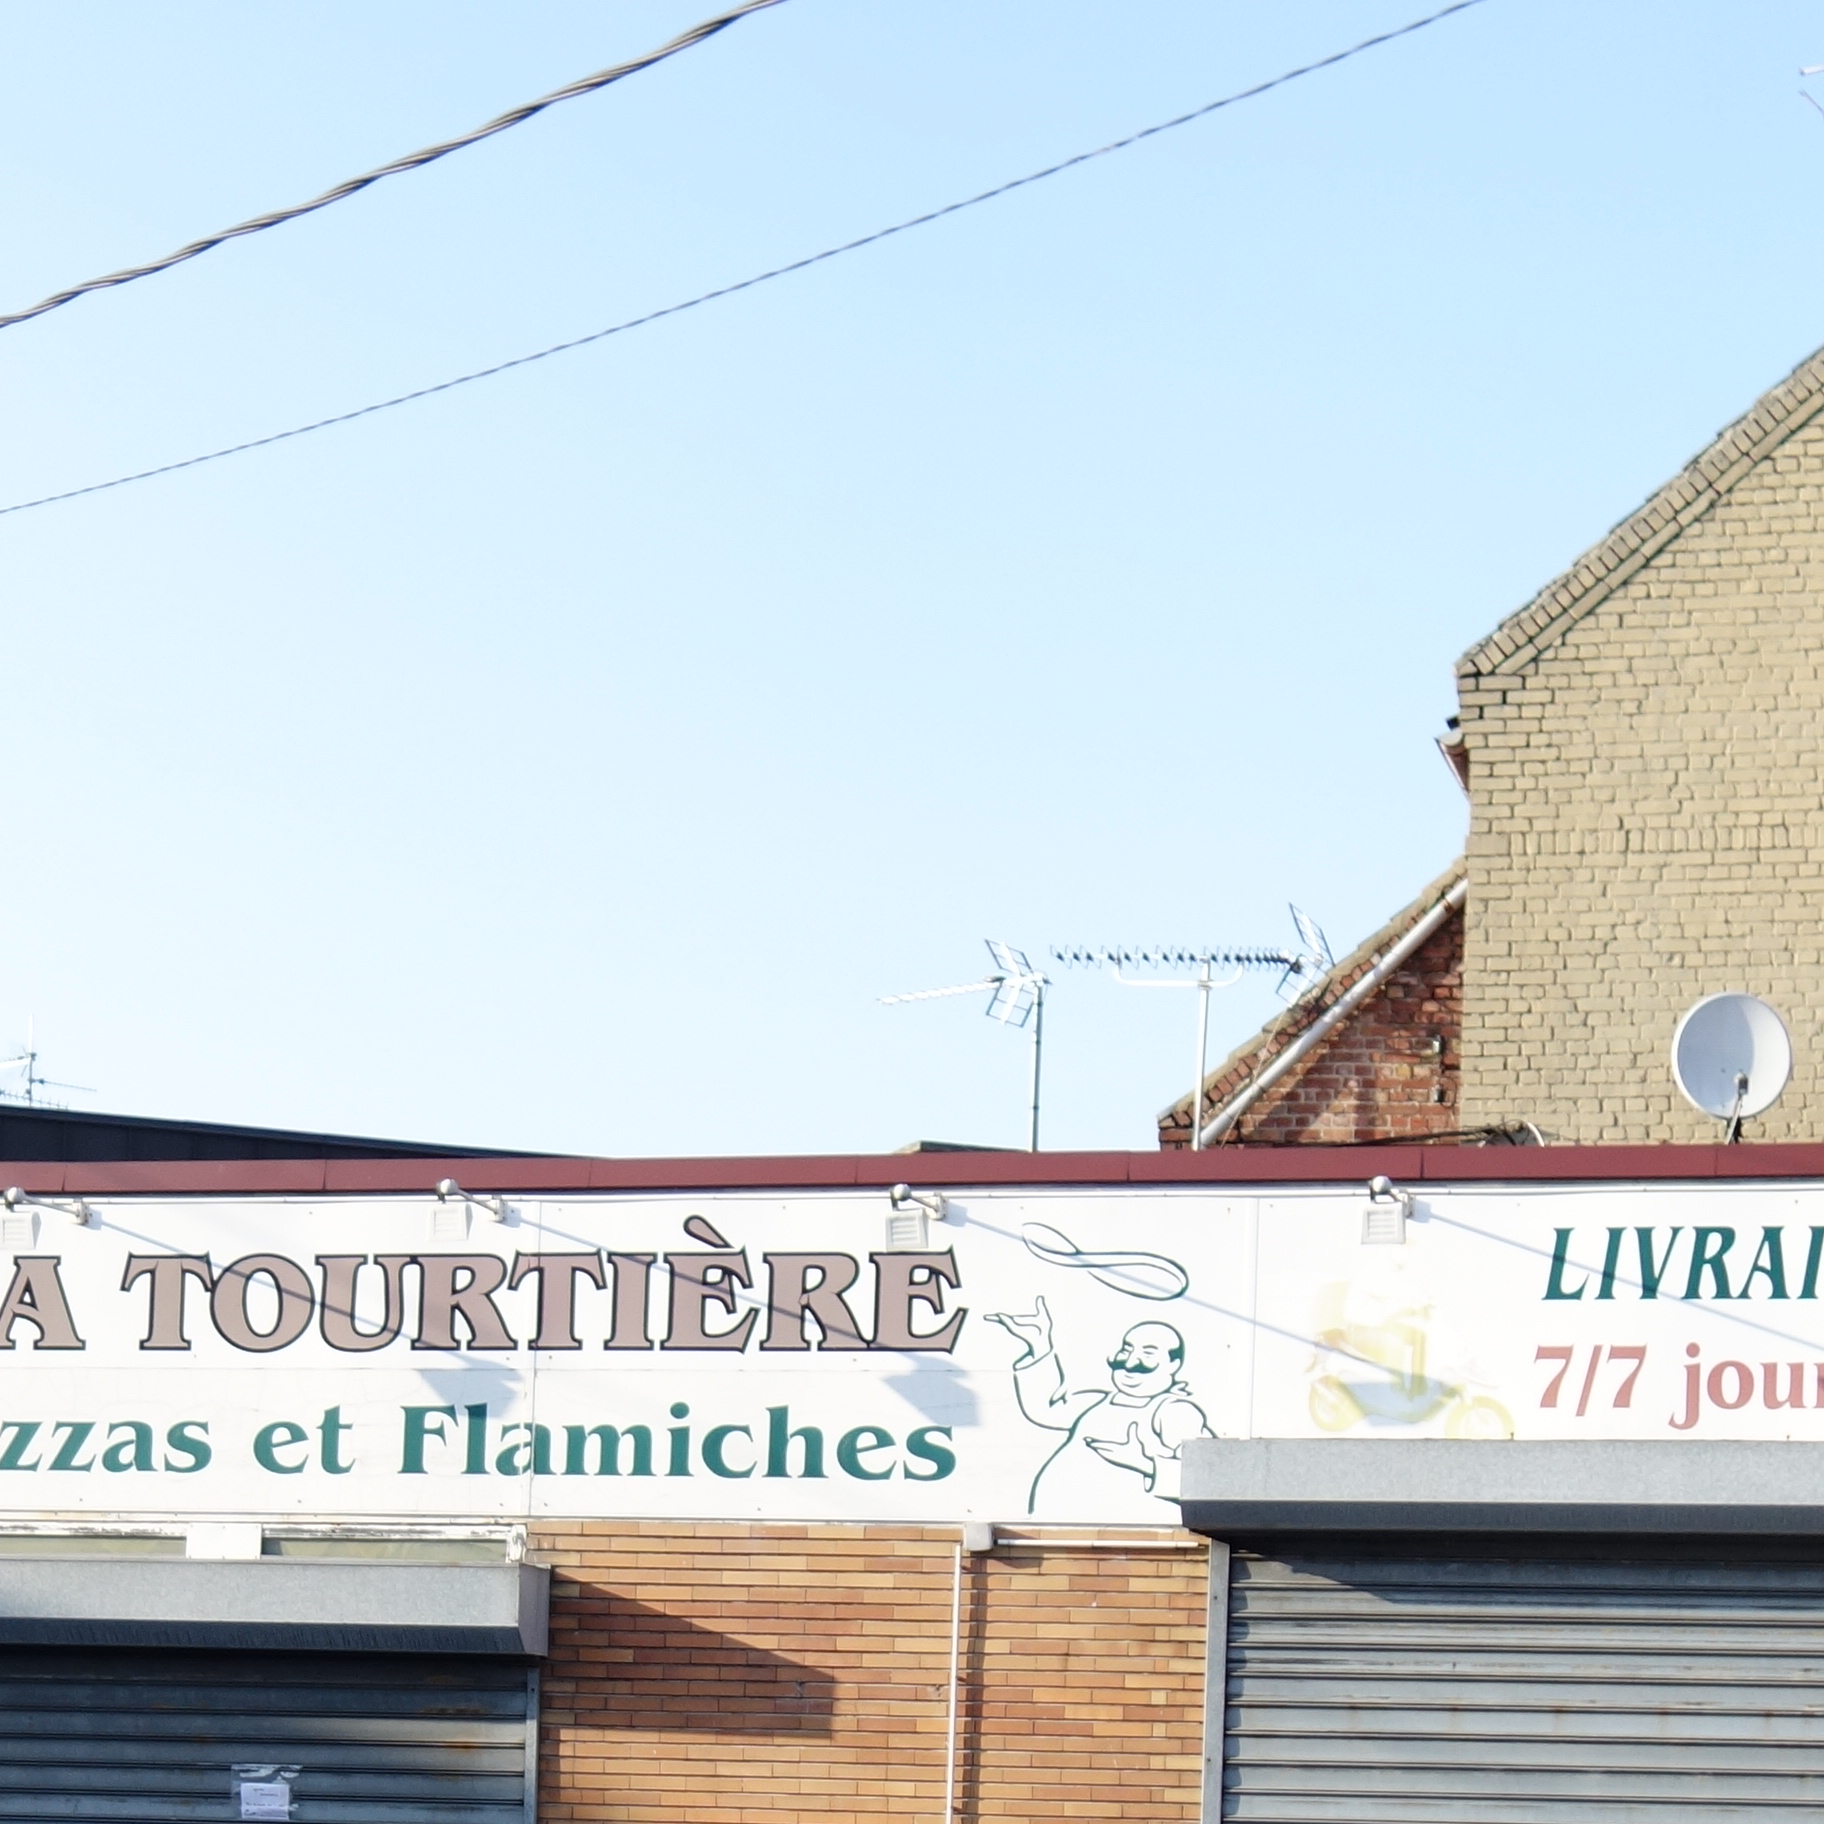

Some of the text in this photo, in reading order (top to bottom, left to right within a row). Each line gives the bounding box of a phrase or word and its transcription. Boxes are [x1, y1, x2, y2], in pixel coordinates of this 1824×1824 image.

[120, 1214, 969, 1354] TOURTIÈRE
[1533, 1343, 1649, 1418] 7/7
[252, 1404, 356, 1476] et
[397, 1402, 958, 1482] Flamiches
